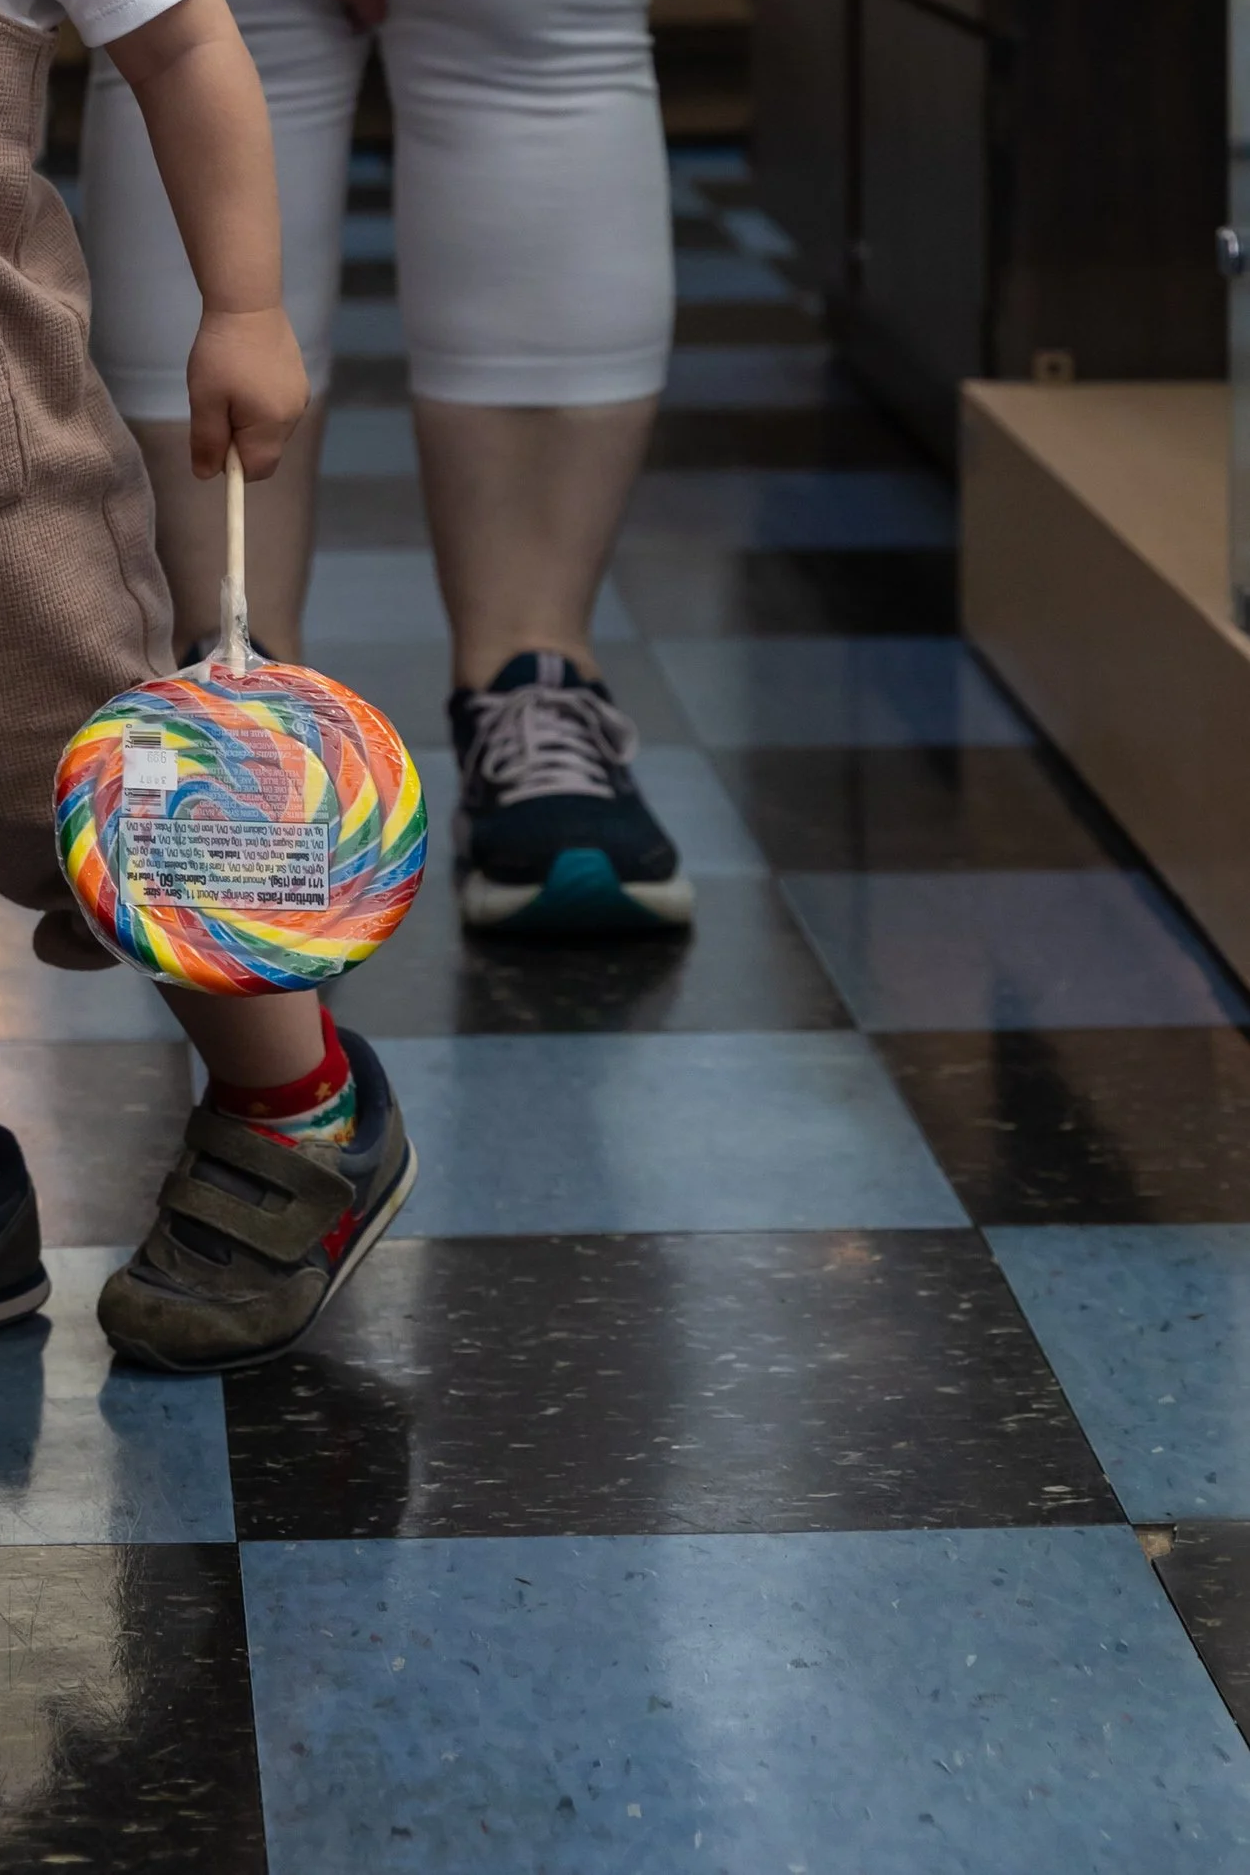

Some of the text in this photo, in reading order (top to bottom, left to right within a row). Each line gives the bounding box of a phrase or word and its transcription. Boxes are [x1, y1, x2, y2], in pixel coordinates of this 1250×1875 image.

[243, 826, 268, 835] Calcium
[211, 837, 230, 846] Added
[295, 840, 309, 849] Total
[225, 851, 240, 859] Total
[286, 852, 309, 861] Sodium
[139, 873, 154, 881] Total
[173, 874, 206, 885] Calories
[231, 876, 241, 884] per
[243, 877, 267, 885] Amount
[291, 876, 306, 886] pop
[308, 878, 324, 888] 1/11
[197, 890, 219, 901] About
[257, 892, 283, 904] Facts
[285, 892, 324, 905] Nutrition
